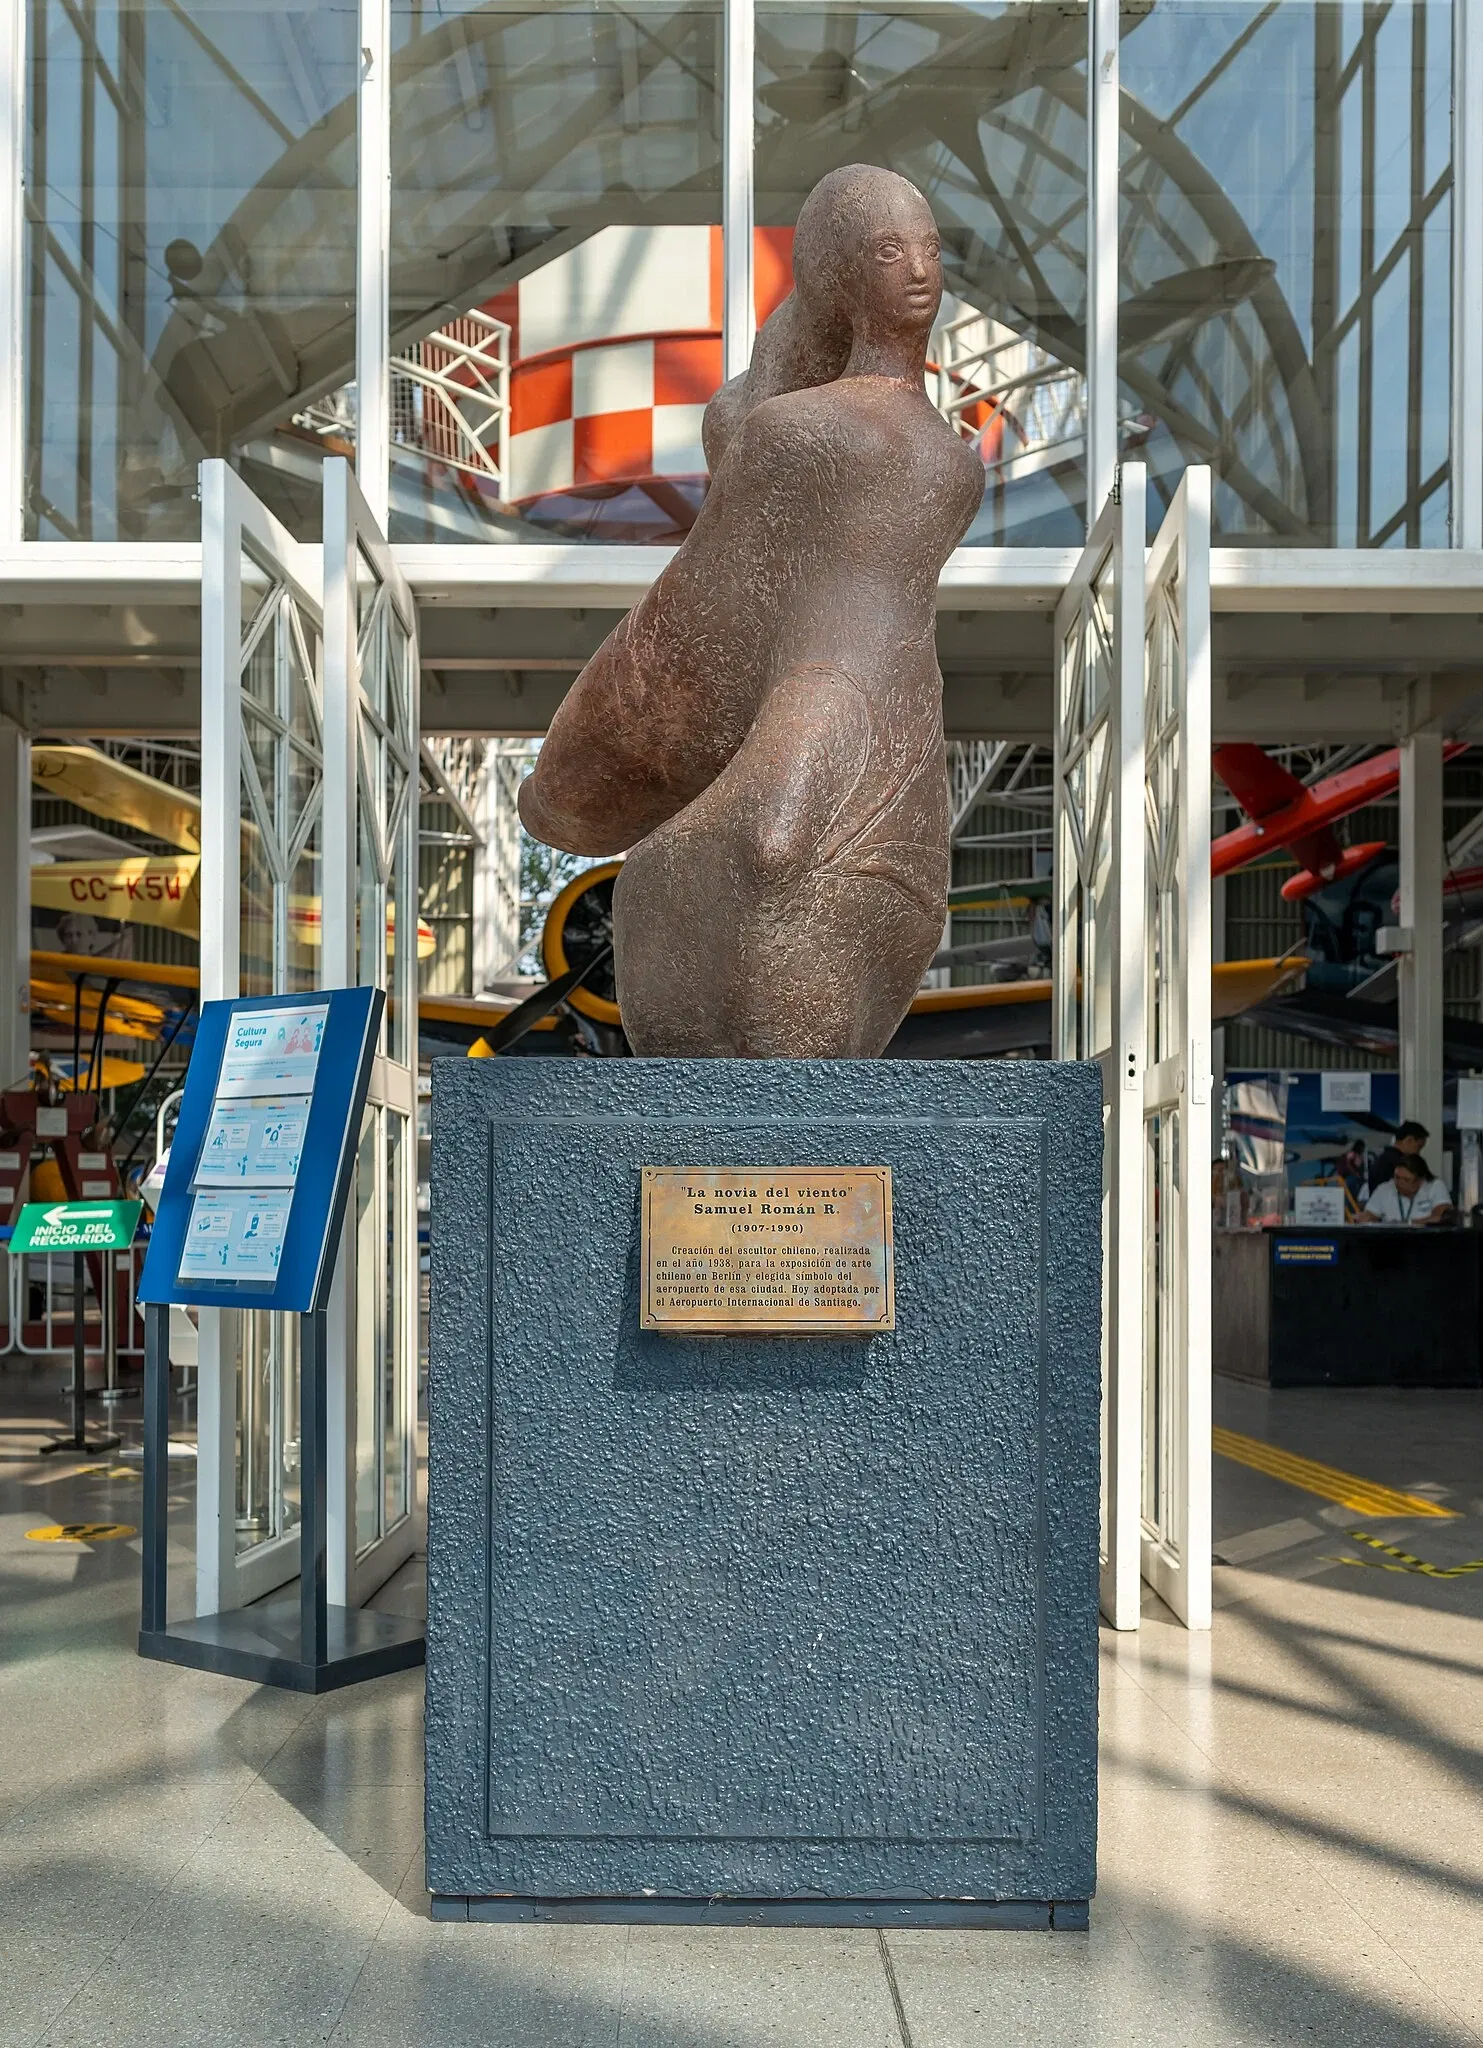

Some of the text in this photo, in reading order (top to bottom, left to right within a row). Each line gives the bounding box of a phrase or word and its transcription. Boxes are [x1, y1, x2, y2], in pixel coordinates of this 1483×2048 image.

[237, 1027, 267, 1036] Cultura
[235, 1039, 263, 1049] Segura
[681, 1186, 853, 1198] "La novia del viento"
[694, 1204, 840, 1215] Samuel Román R.
[35, 1224, 113, 1235] INICIO DEL
[731, 1224, 804, 1233] (1907-1990)
[29, 1233, 116, 1246] RECORRIDO
[672, 1246, 871, 1256] Creación del escultor chileno, realizada
[656, 1259, 872, 1269] en el año 1938, para la exposición de arte
[656, 1272, 691, 1280] chileno
[712, 1271, 741, 1280] Berlín
[746, 1274, 750, 1282] y
[755, 1272, 791, 1282] elegida
[795, 1271, 833, 1280] símbolo
[837, 1272, 852, 1280] del
[656, 1286, 709, 1295] aeropuerto
[713, 1285, 725, 1293] de
[751, 1285, 787, 1293] ciudad.
[791, 1285, 809, 1295] Hoy
[813, 1285, 859, 1295] adoptada
[864, 1286, 880, 1295] por
[656, 1298, 861, 1308] el Aeropuerto Internacional de Santiago.
